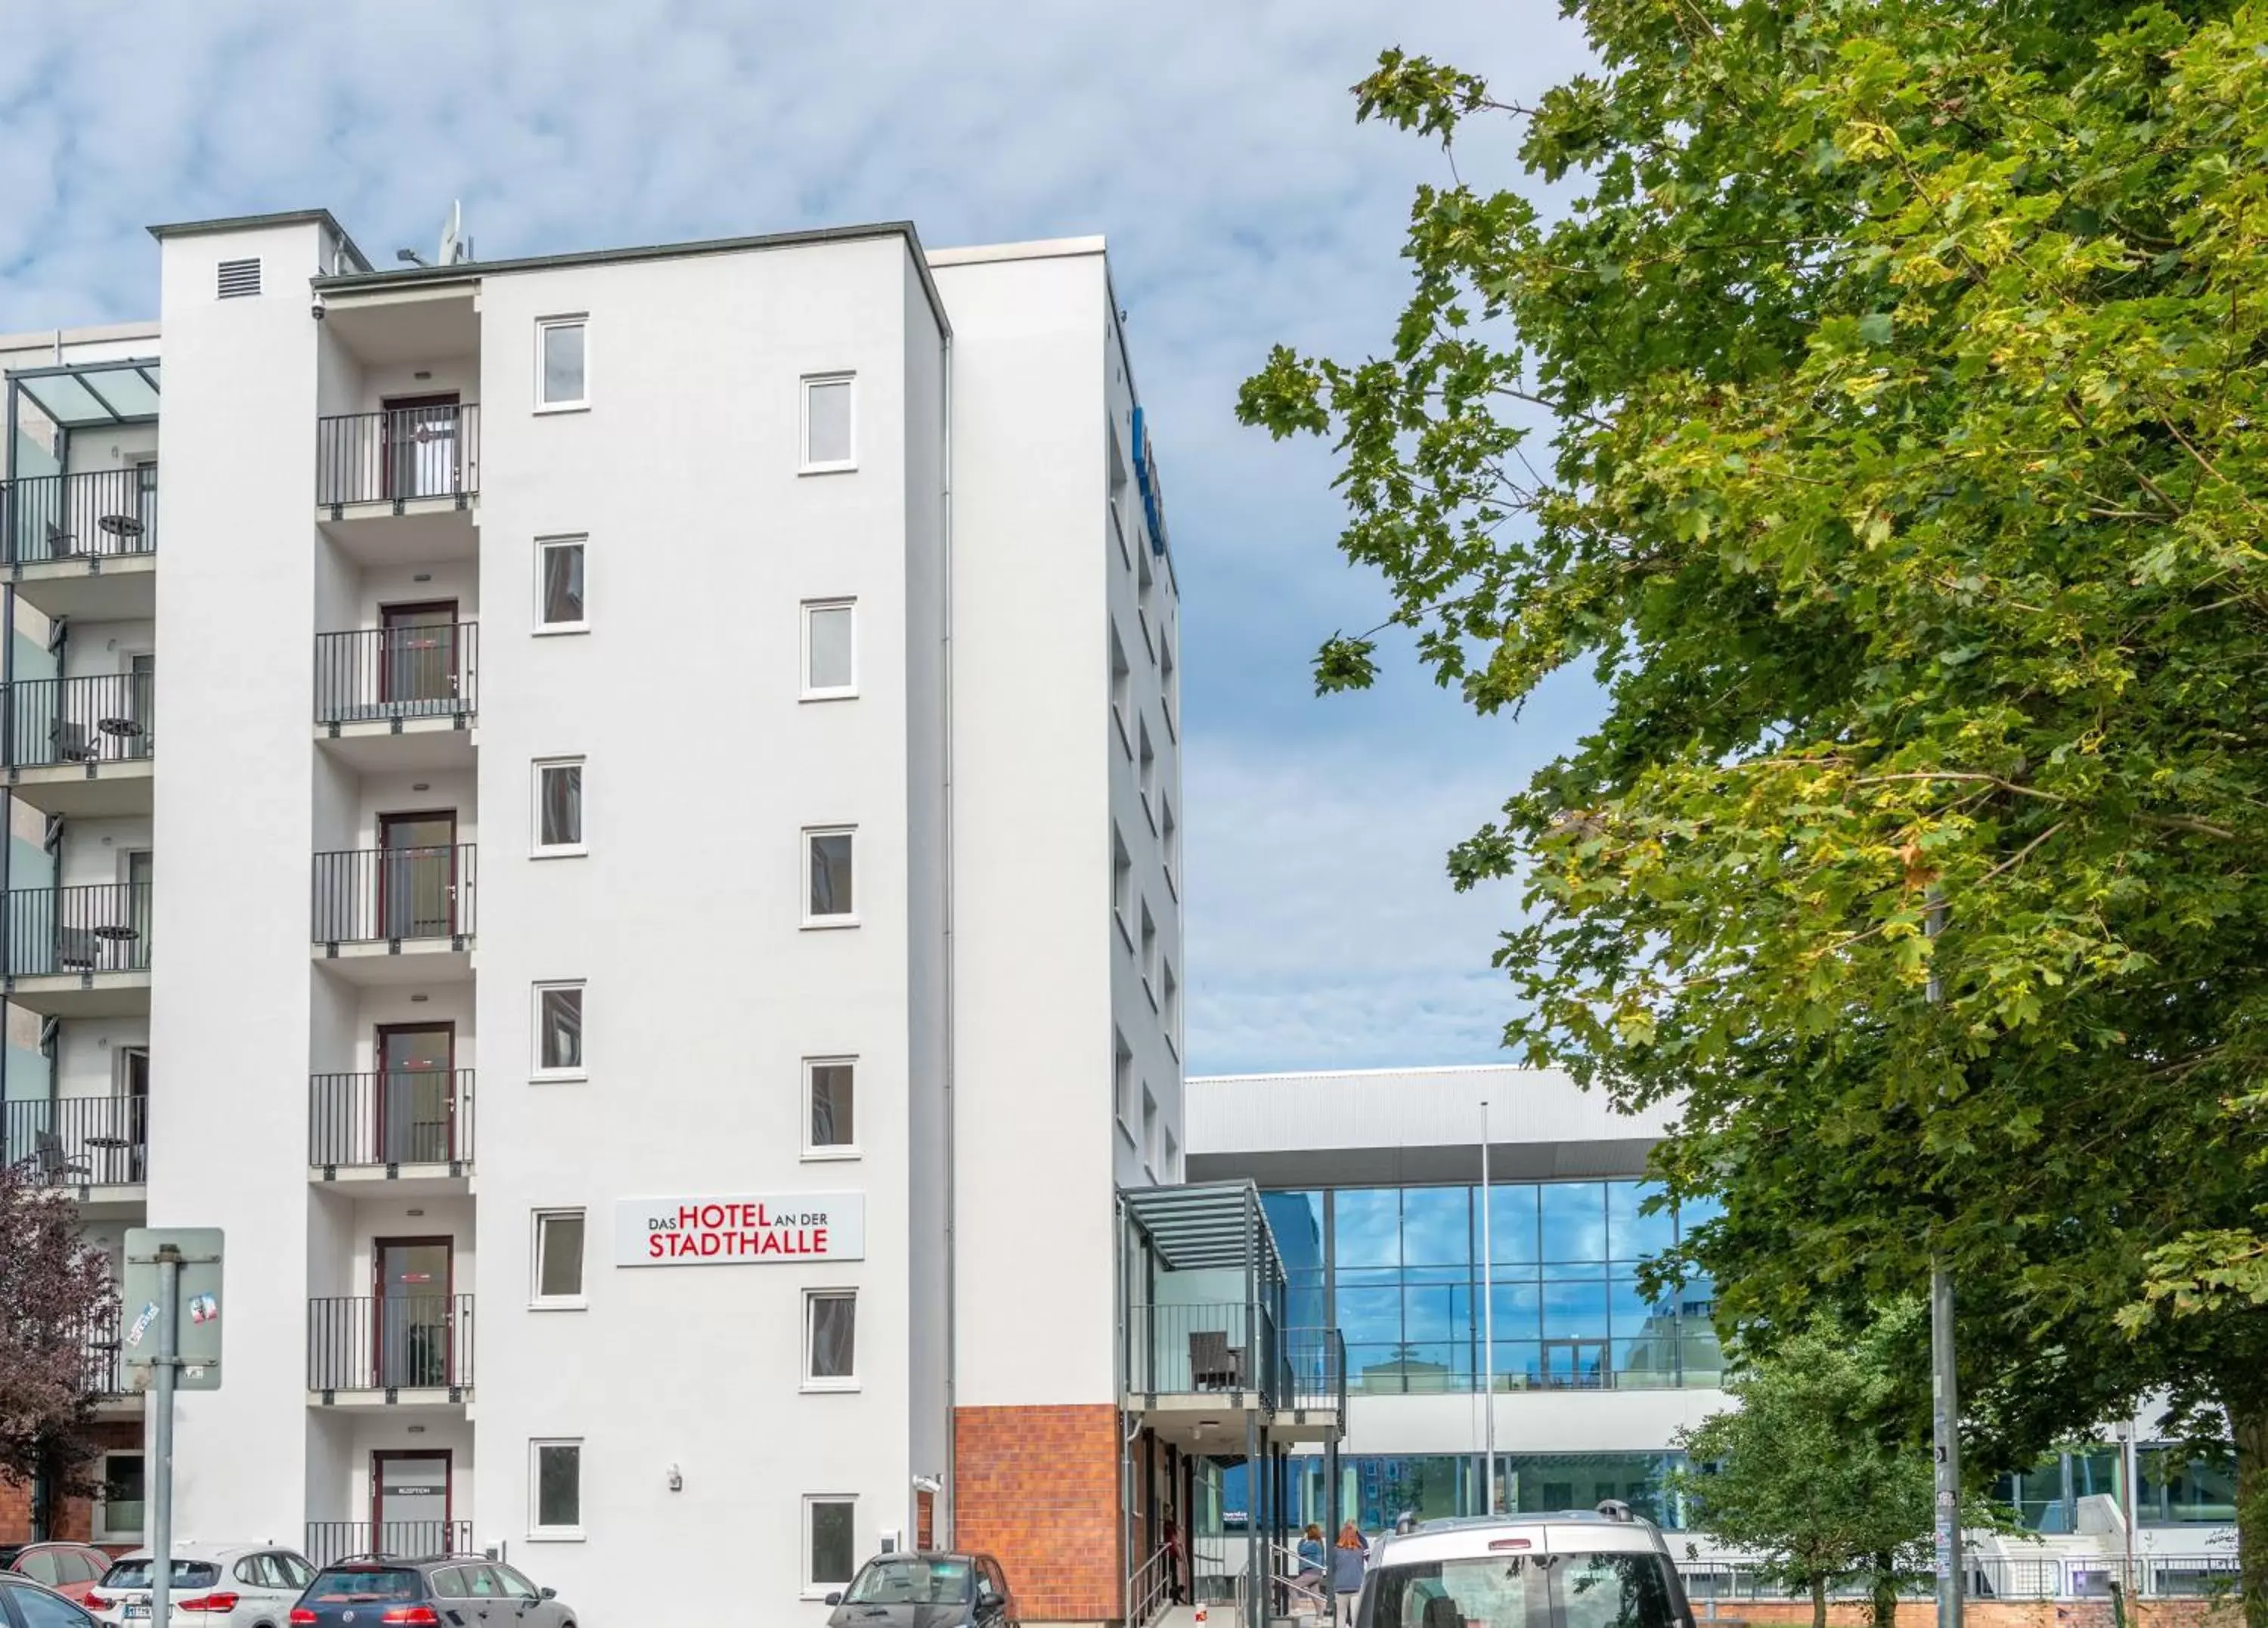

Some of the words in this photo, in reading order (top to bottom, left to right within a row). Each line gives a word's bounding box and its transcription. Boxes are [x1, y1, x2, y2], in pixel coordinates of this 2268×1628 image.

[648, 1218, 677, 1230] DAS
[679, 1203, 771, 1229] HOTEL
[774, 1215, 796, 1227] AN
[800, 1212, 829, 1226] DER
[649, 1229, 827, 1258] STADTHALLE
